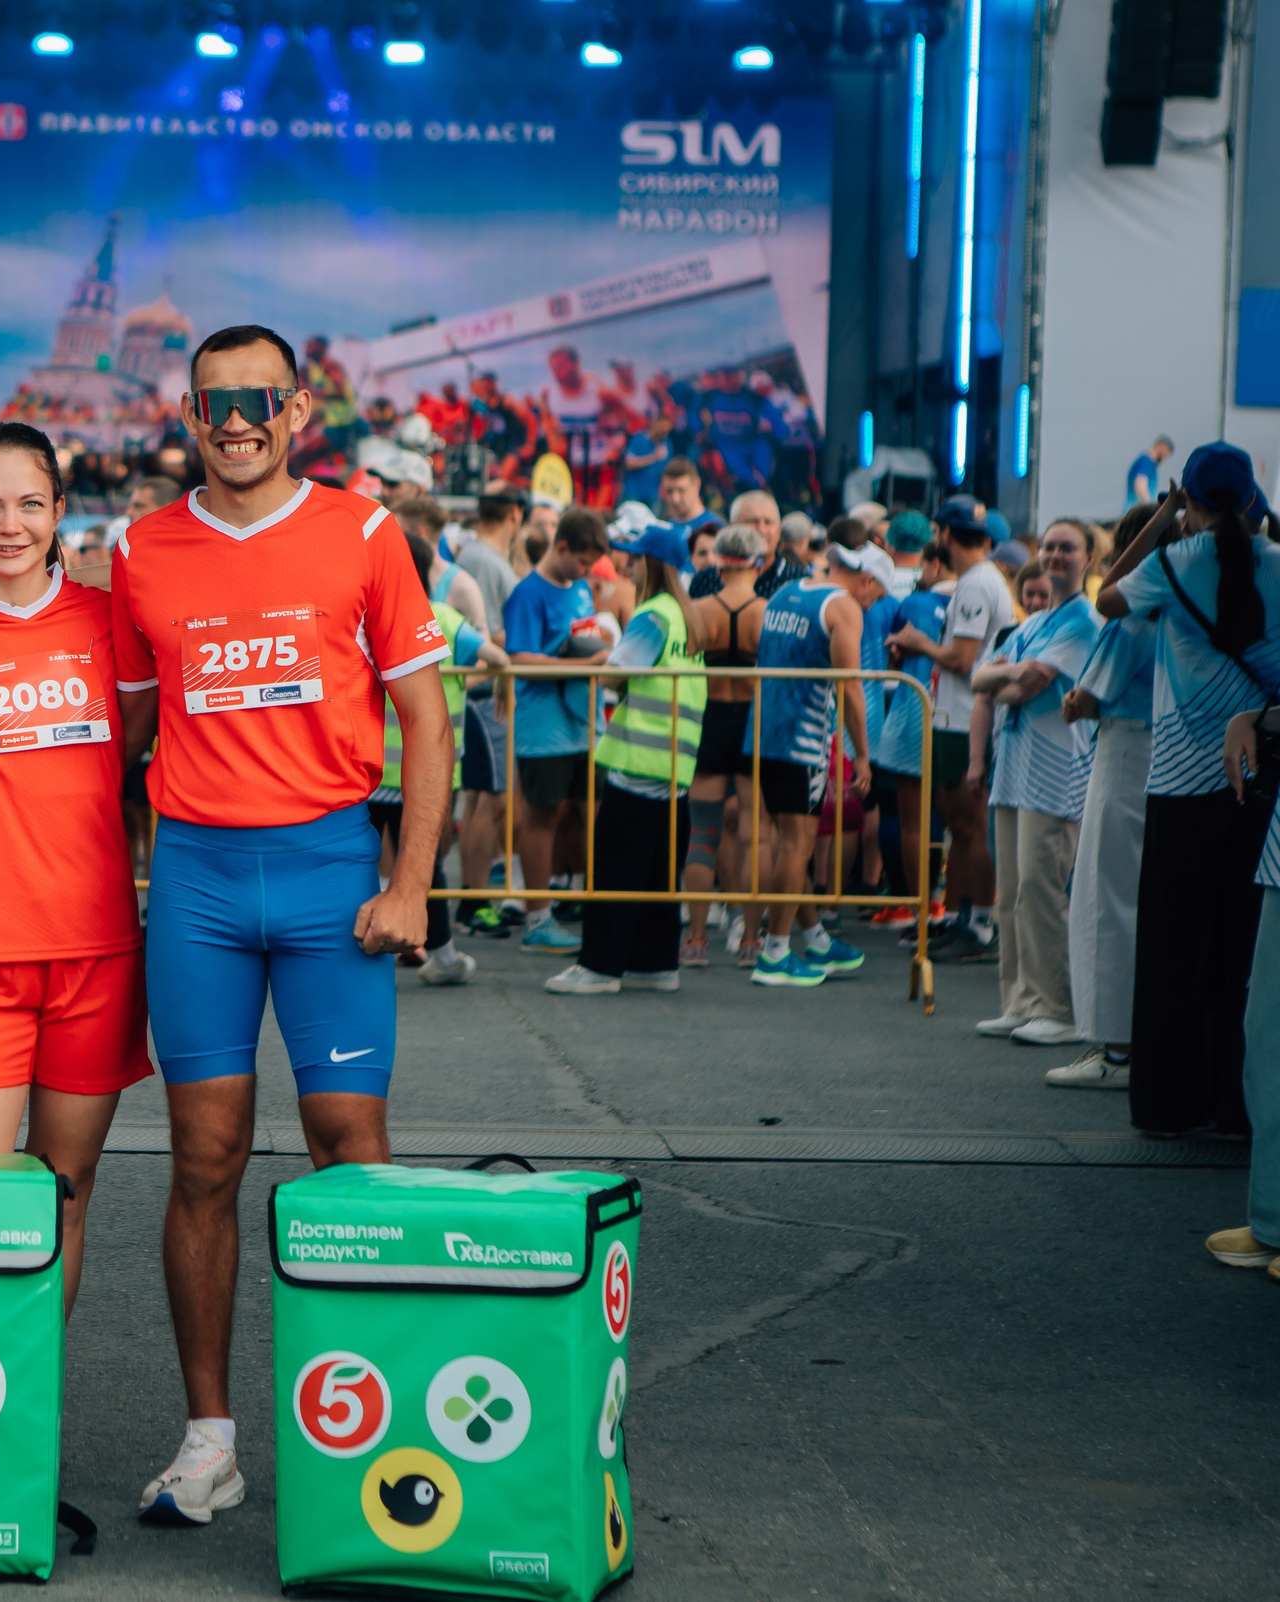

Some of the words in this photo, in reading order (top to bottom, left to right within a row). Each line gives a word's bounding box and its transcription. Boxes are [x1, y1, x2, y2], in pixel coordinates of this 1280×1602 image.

[40, 112, 278, 138] ПРАВИТЕЛЬСТВО
[289, 117, 413, 140] ОМСКОЙ
[424, 120, 556, 143] ОБЛАСТИ
[620, 171, 778, 194] СИБИРСКИЙ
[618, 208, 778, 234] МАРАФОН
[199, 635, 299, 674] 2875
[209, 696, 226, 705] Альфа
[288, 1219, 403, 1240] Доставляем
[288, 1242, 379, 1262] продукты
[611, 1250, 625, 1324] 5
[317, 1362, 369, 1438] 5
